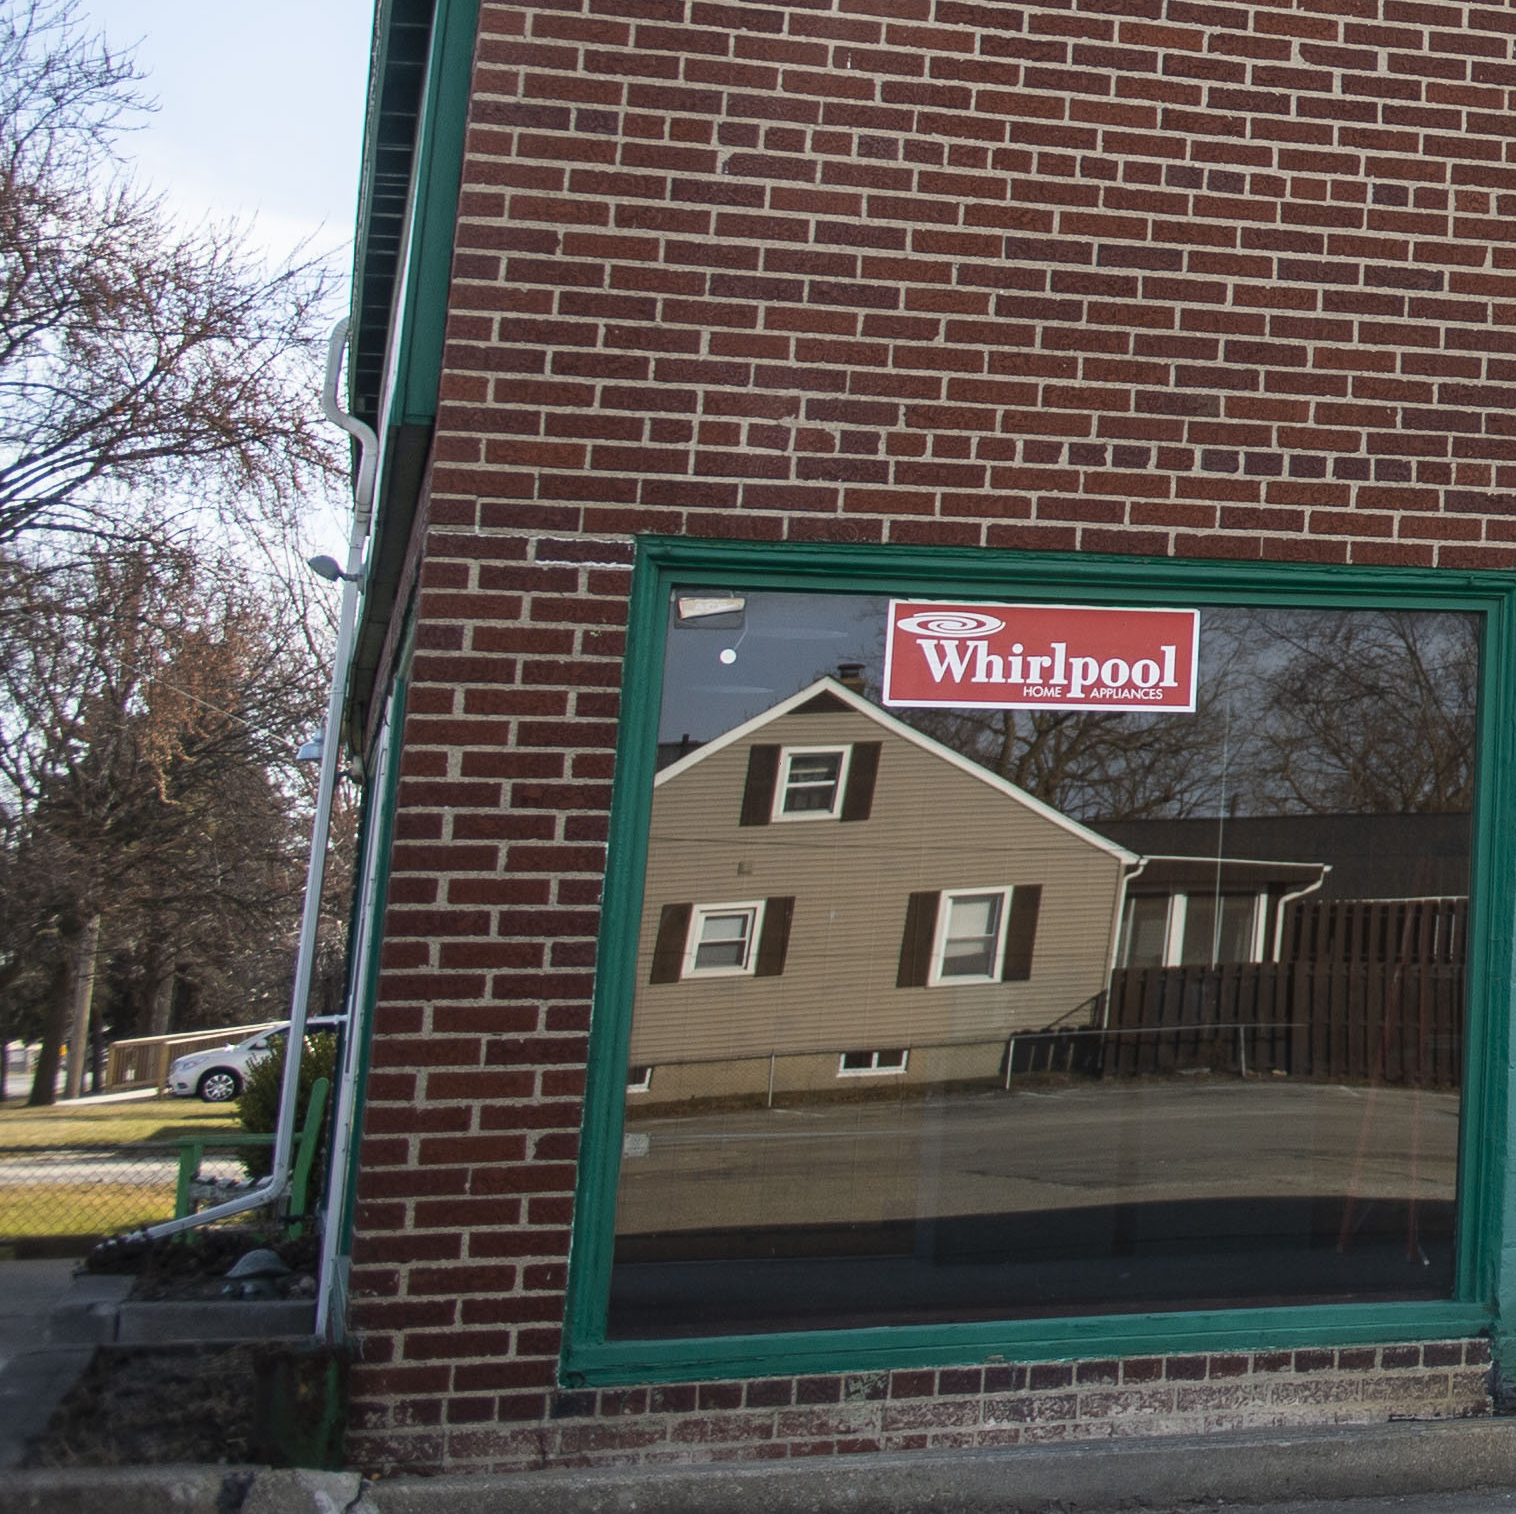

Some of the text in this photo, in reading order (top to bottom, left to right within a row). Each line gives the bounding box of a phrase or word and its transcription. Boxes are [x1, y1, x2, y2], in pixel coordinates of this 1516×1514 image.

[916, 638, 1178, 698] Whirlpool
[1023, 685, 1163, 700] HOME APPLIANCES
